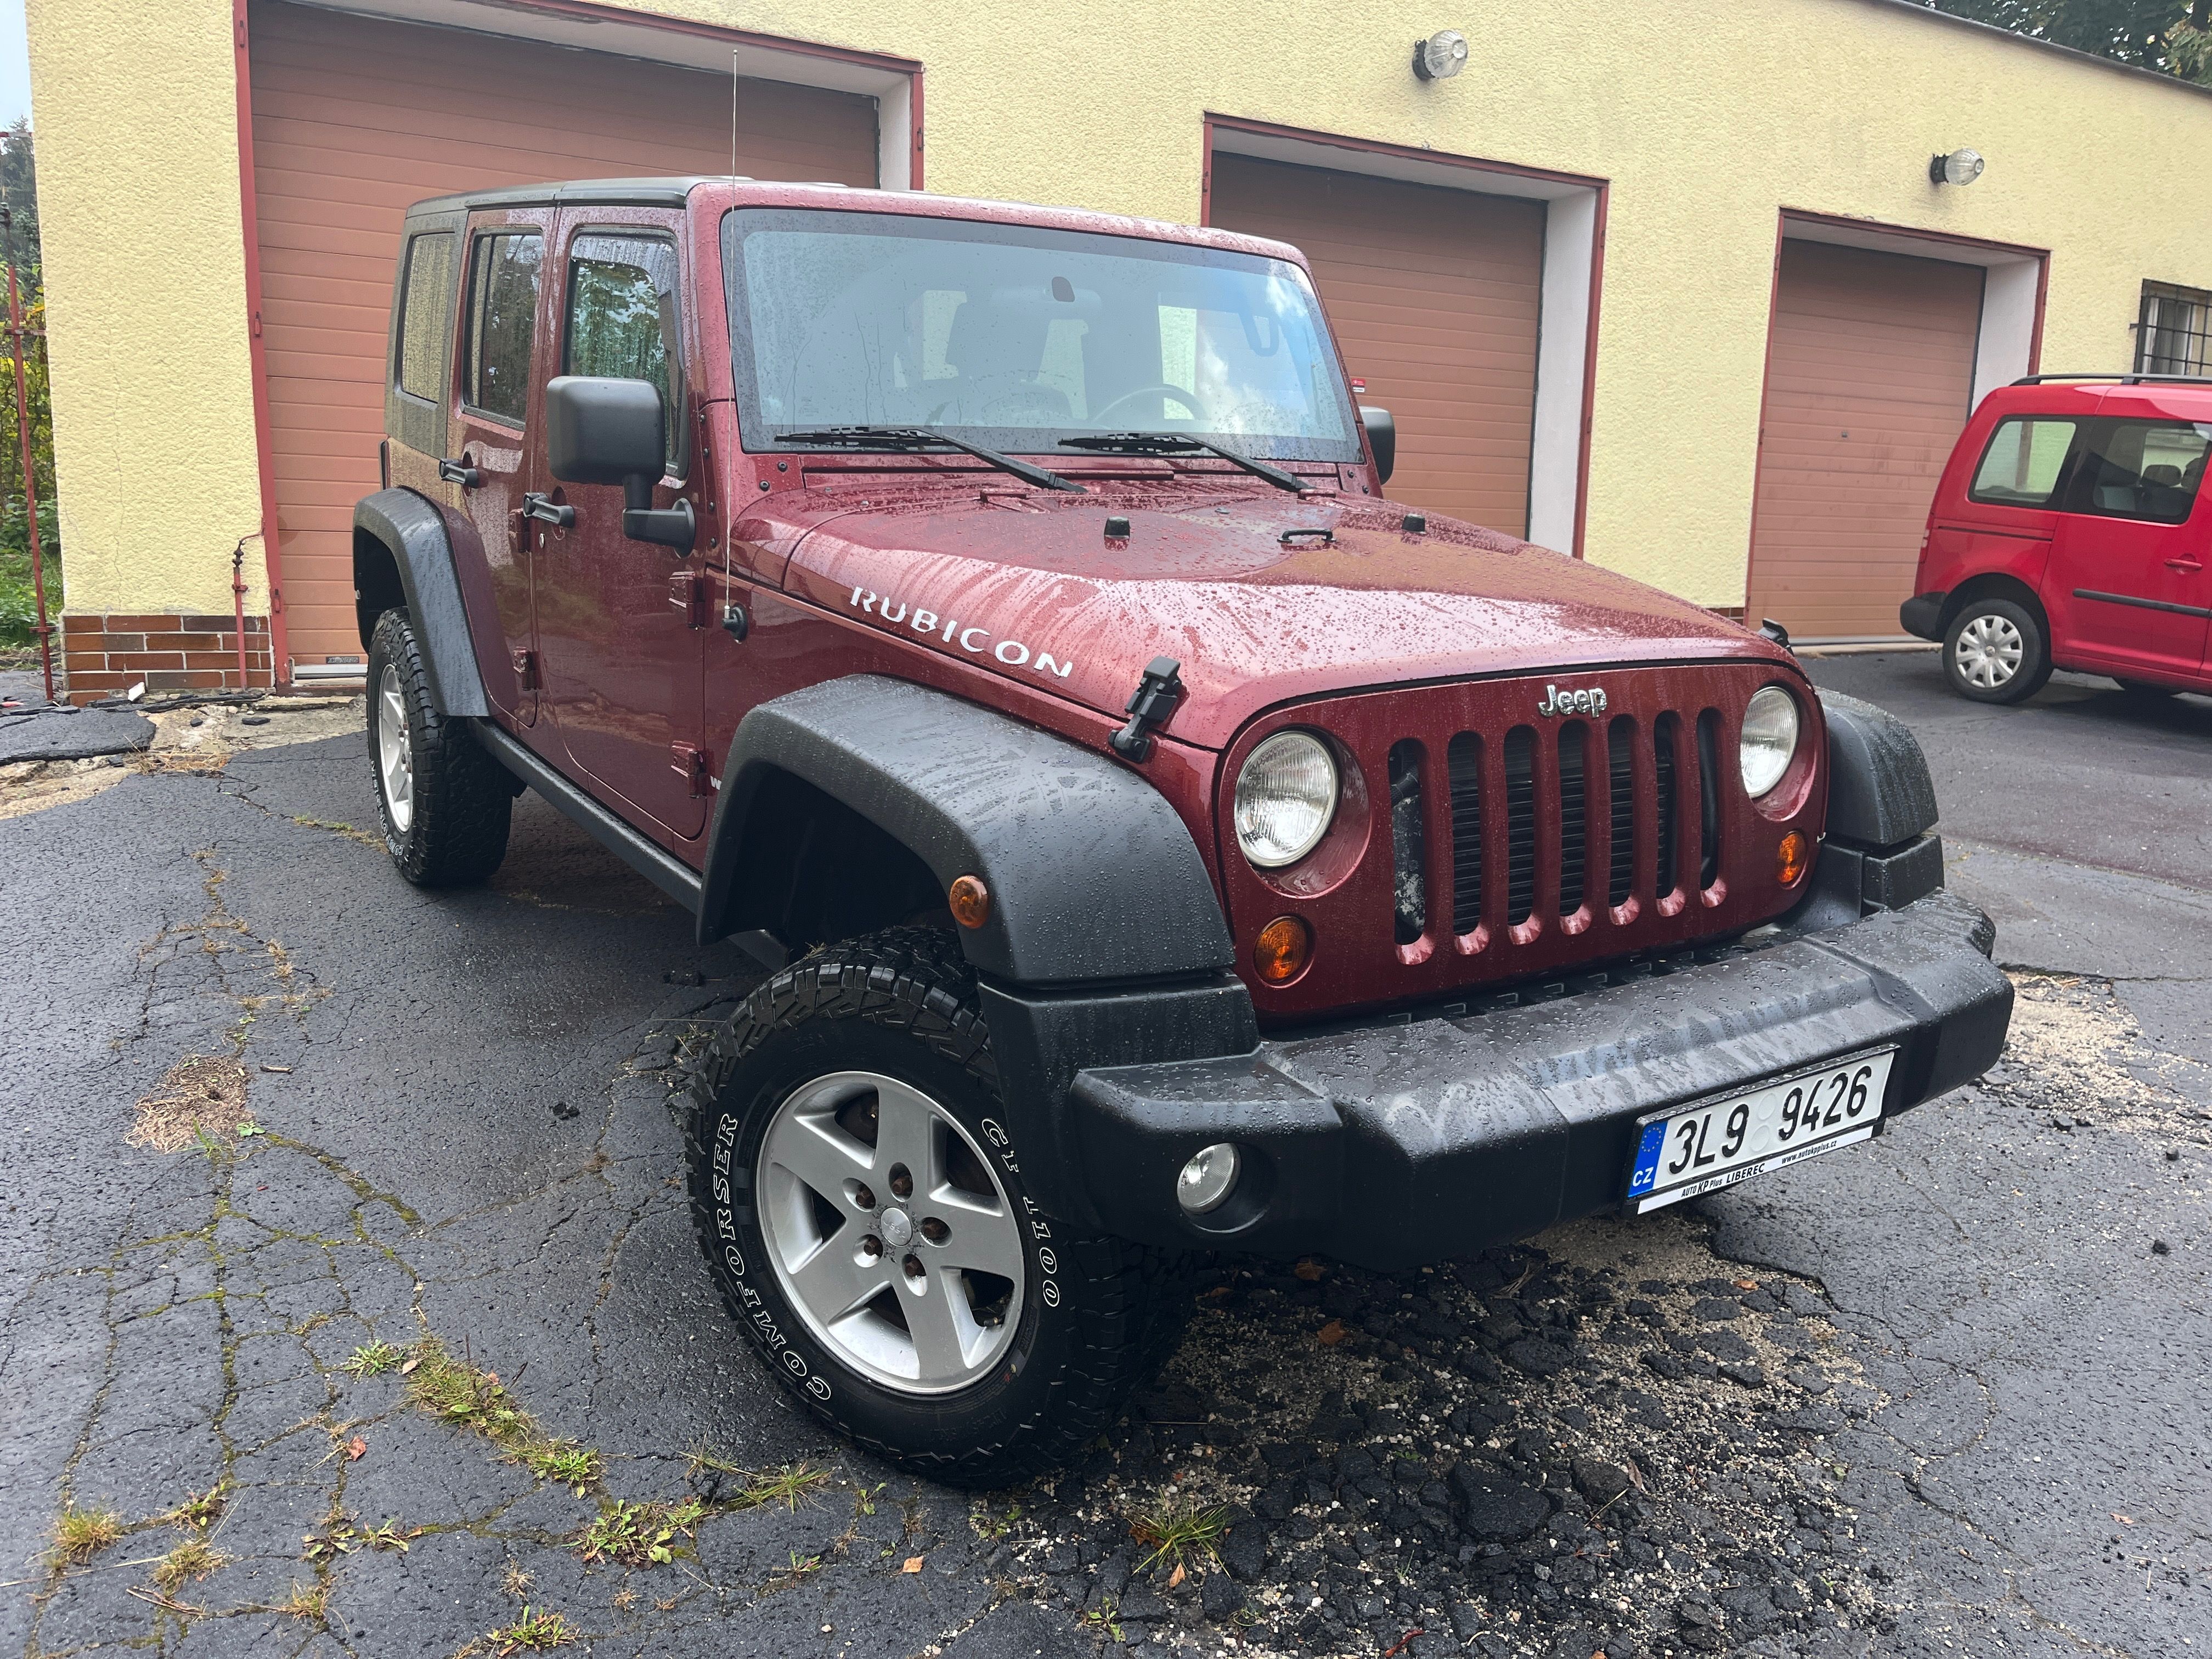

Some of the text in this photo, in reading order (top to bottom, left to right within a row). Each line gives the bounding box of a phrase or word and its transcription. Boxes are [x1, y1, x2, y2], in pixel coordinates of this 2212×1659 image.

[850, 586, 1073, 678] RUBICON
[1538, 684, 1607, 718] Jeep
[1669, 1065, 1872, 1174] 3L9 9426
[1632, 1166, 1654, 1187] CZ
[1681, 1140, 1837, 1198] AUTO KP Plus LIBEREC www.autokpplus.cz
[713, 1113, 832, 1400] COMFORSER
[1023, 1196, 1060, 1307] 1100
